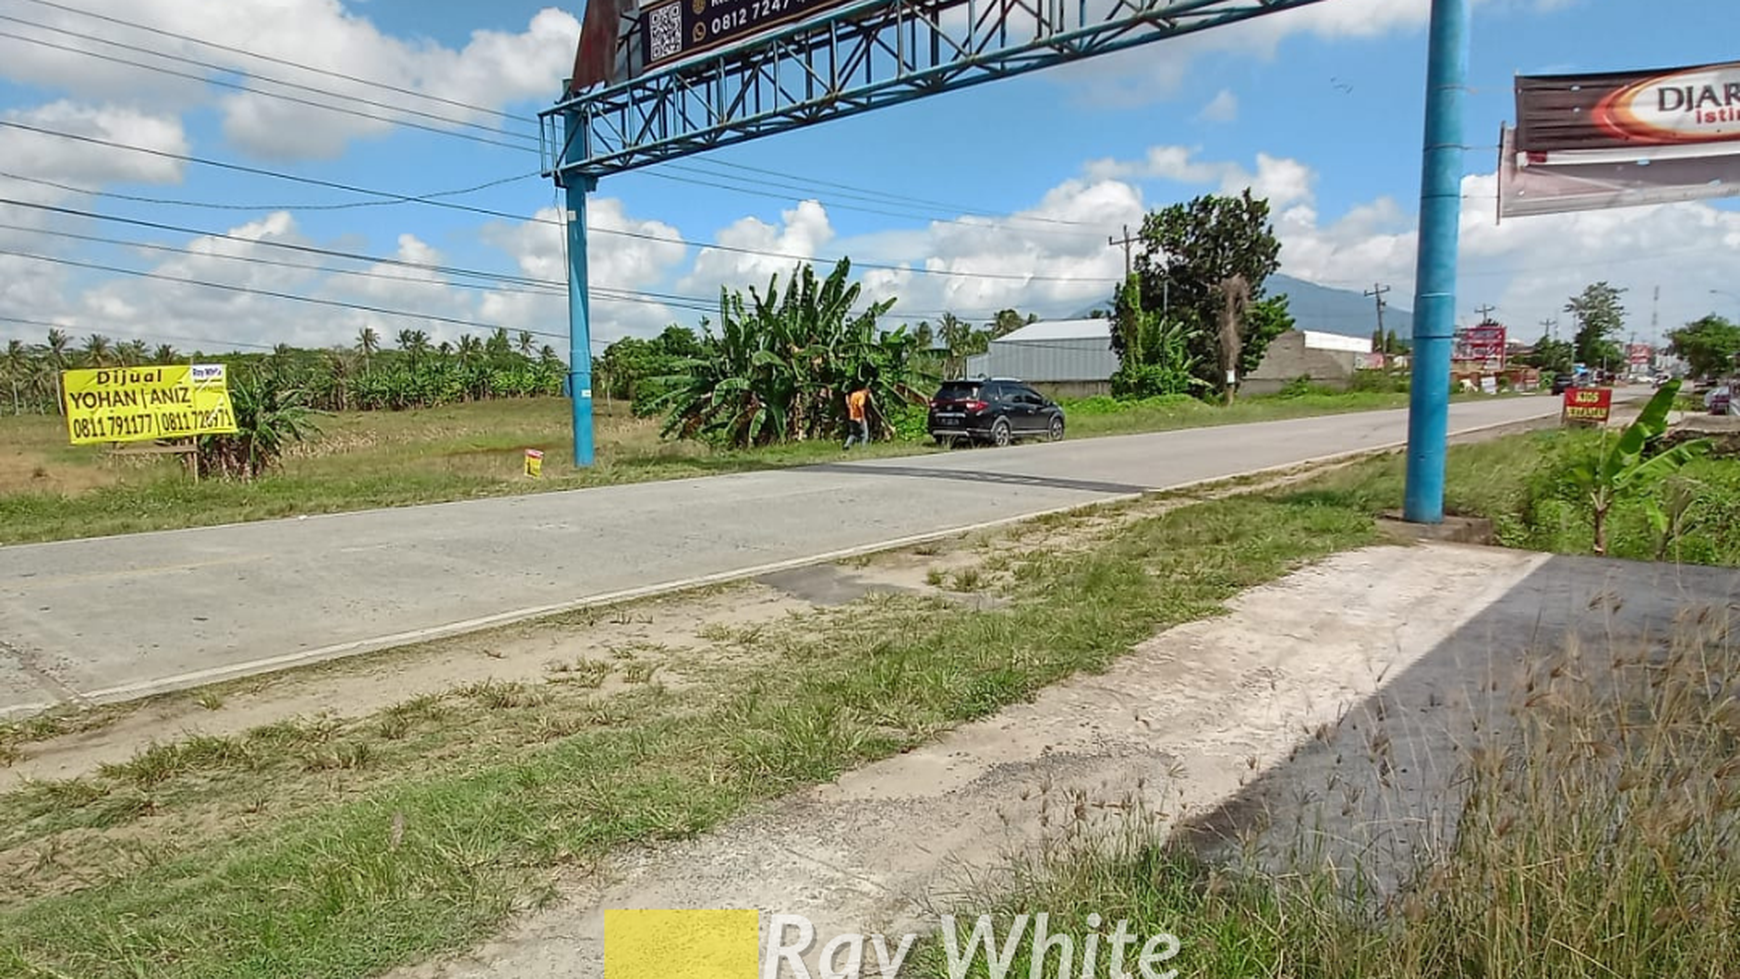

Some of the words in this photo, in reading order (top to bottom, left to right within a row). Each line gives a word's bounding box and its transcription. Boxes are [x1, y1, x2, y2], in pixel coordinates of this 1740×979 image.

[711, 8, 747, 34] 0812
[1657, 82, 1740, 113] DJAR
[1695, 107, 1740, 124] isti
[97, 369, 162, 386] Dijual
[69, 389, 138, 410] YOHAN
[151, 387, 191, 405] ANIZ
[73, 417, 106, 438] 0811
[107, 414, 152, 436] 791177
[161, 412, 191, 431] 0811
